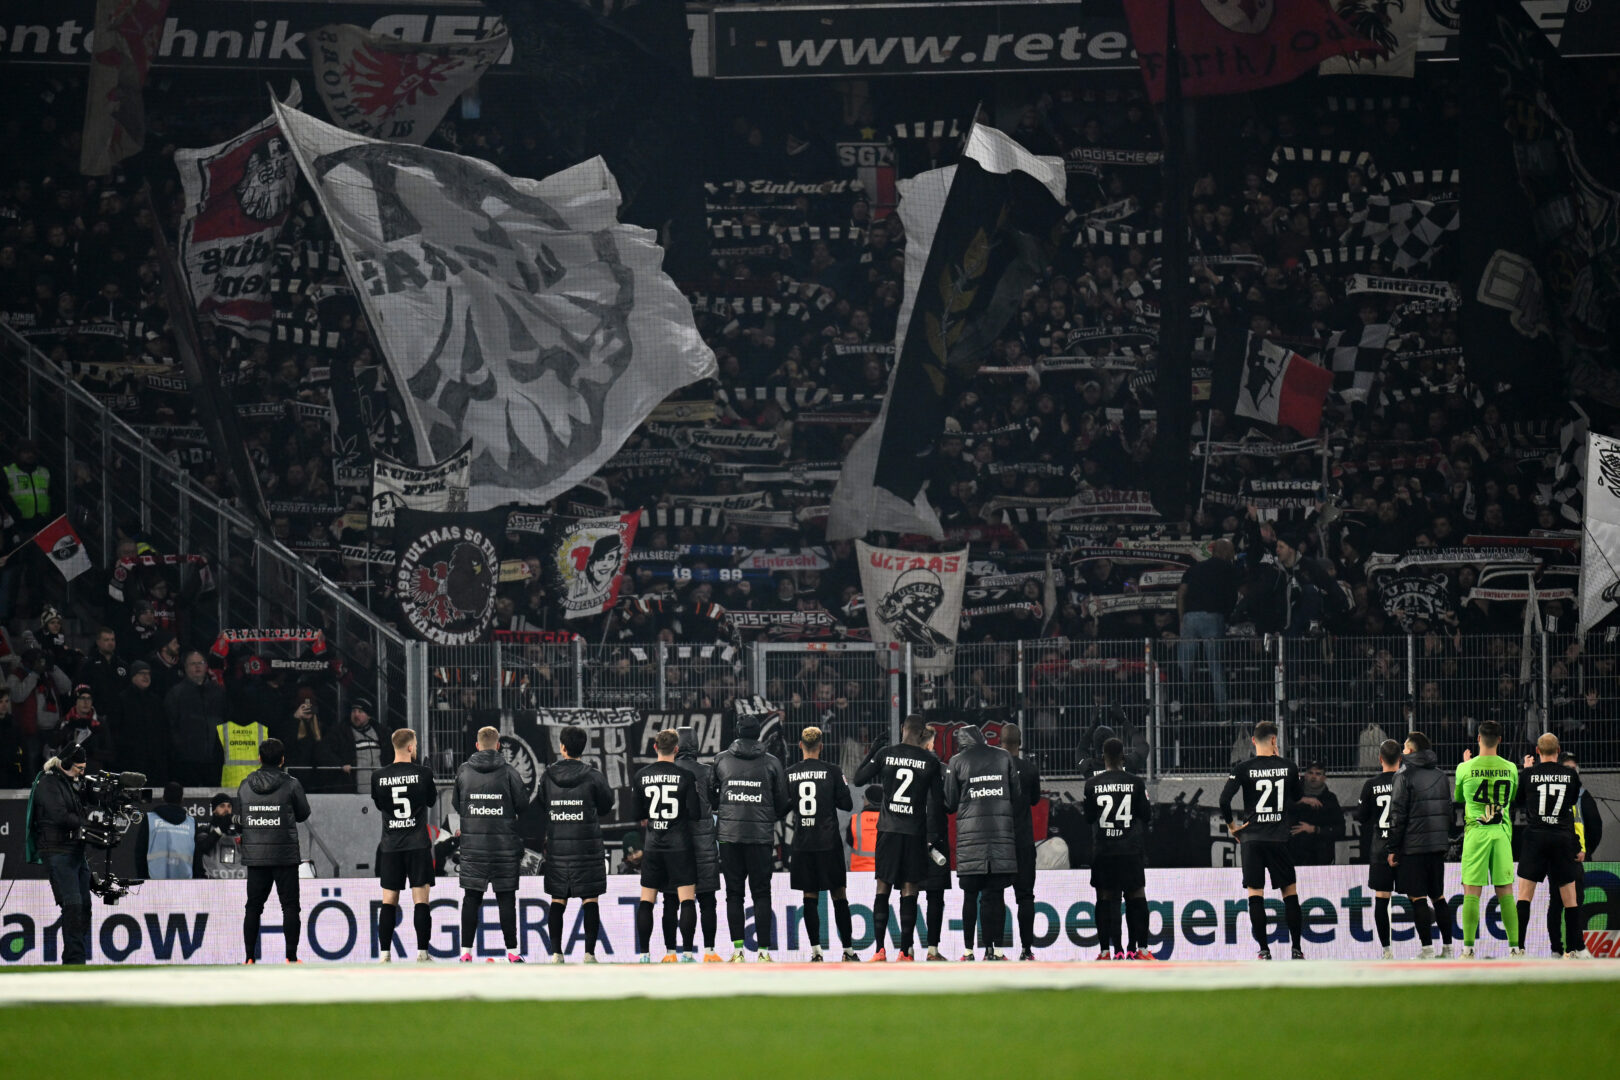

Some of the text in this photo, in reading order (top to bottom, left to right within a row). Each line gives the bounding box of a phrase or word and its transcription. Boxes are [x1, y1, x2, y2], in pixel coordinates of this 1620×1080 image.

[778, 27, 1140, 67] www.rete
[749, 179, 848, 194] Eintract
[1366, 277, 1449, 297] Eintracht
[147, 374, 189, 391] MAGI
[691, 429, 778, 449] Frankfurt
[404, 526, 461, 570] ULTRAS
[628, 551, 680, 562] OKALSIEGER
[753, 556, 817, 569] Eintracht
[870, 551, 960, 573] ULTRAS
[899, 583, 939, 598] ULTRAS
[725, 612, 790, 625] AGISCHE
[224, 628, 320, 641] FRANKFURT
[271, 658, 330, 670] Eintracht
[229, 739, 257, 747] ORDNER
[885, 756, 926, 770] FRANKFURT
[788, 770, 827, 784] FRANKFURT
[969, 774, 1003, 784] EINTRACHT
[1249, 767, 1289, 778] FRANKFURT
[1470, 768, 1512, 778] FRANKFURT
[1530, 774, 1571, 784] FRANKFURT
[379, 774, 419, 787] FRANKFURT
[641, 774, 681, 785] FRANKFURT
[727, 779, 762, 788] EINTRACHT
[892, 768, 914, 804] 2
[969, 786, 1003, 799] indeed
[1094, 782, 1135, 794] FRANKFURT
[1472, 779, 1511, 807] 40
[391, 786, 412, 819] 5
[469, 793, 503, 801] EINTRACHT
[645, 785, 679, 820] 25
[726, 790, 762, 803] indeed
[798, 781, 817, 816] 8
[1255, 778, 1285, 814] 21
[1536, 784, 1567, 817] 17
[248, 804, 281, 812] EINTRACHT
[468, 804, 504, 816] indeed
[889, 803, 914, 815] NDICKA
[1096, 793, 1133, 829] 24
[247, 815, 281, 827] indeed
[550, 810, 584, 821] indeed
[801, 817, 816, 827] SOW
[1256, 813, 1282, 823] ALARIO
[1105, 828, 1124, 838] BUTA
